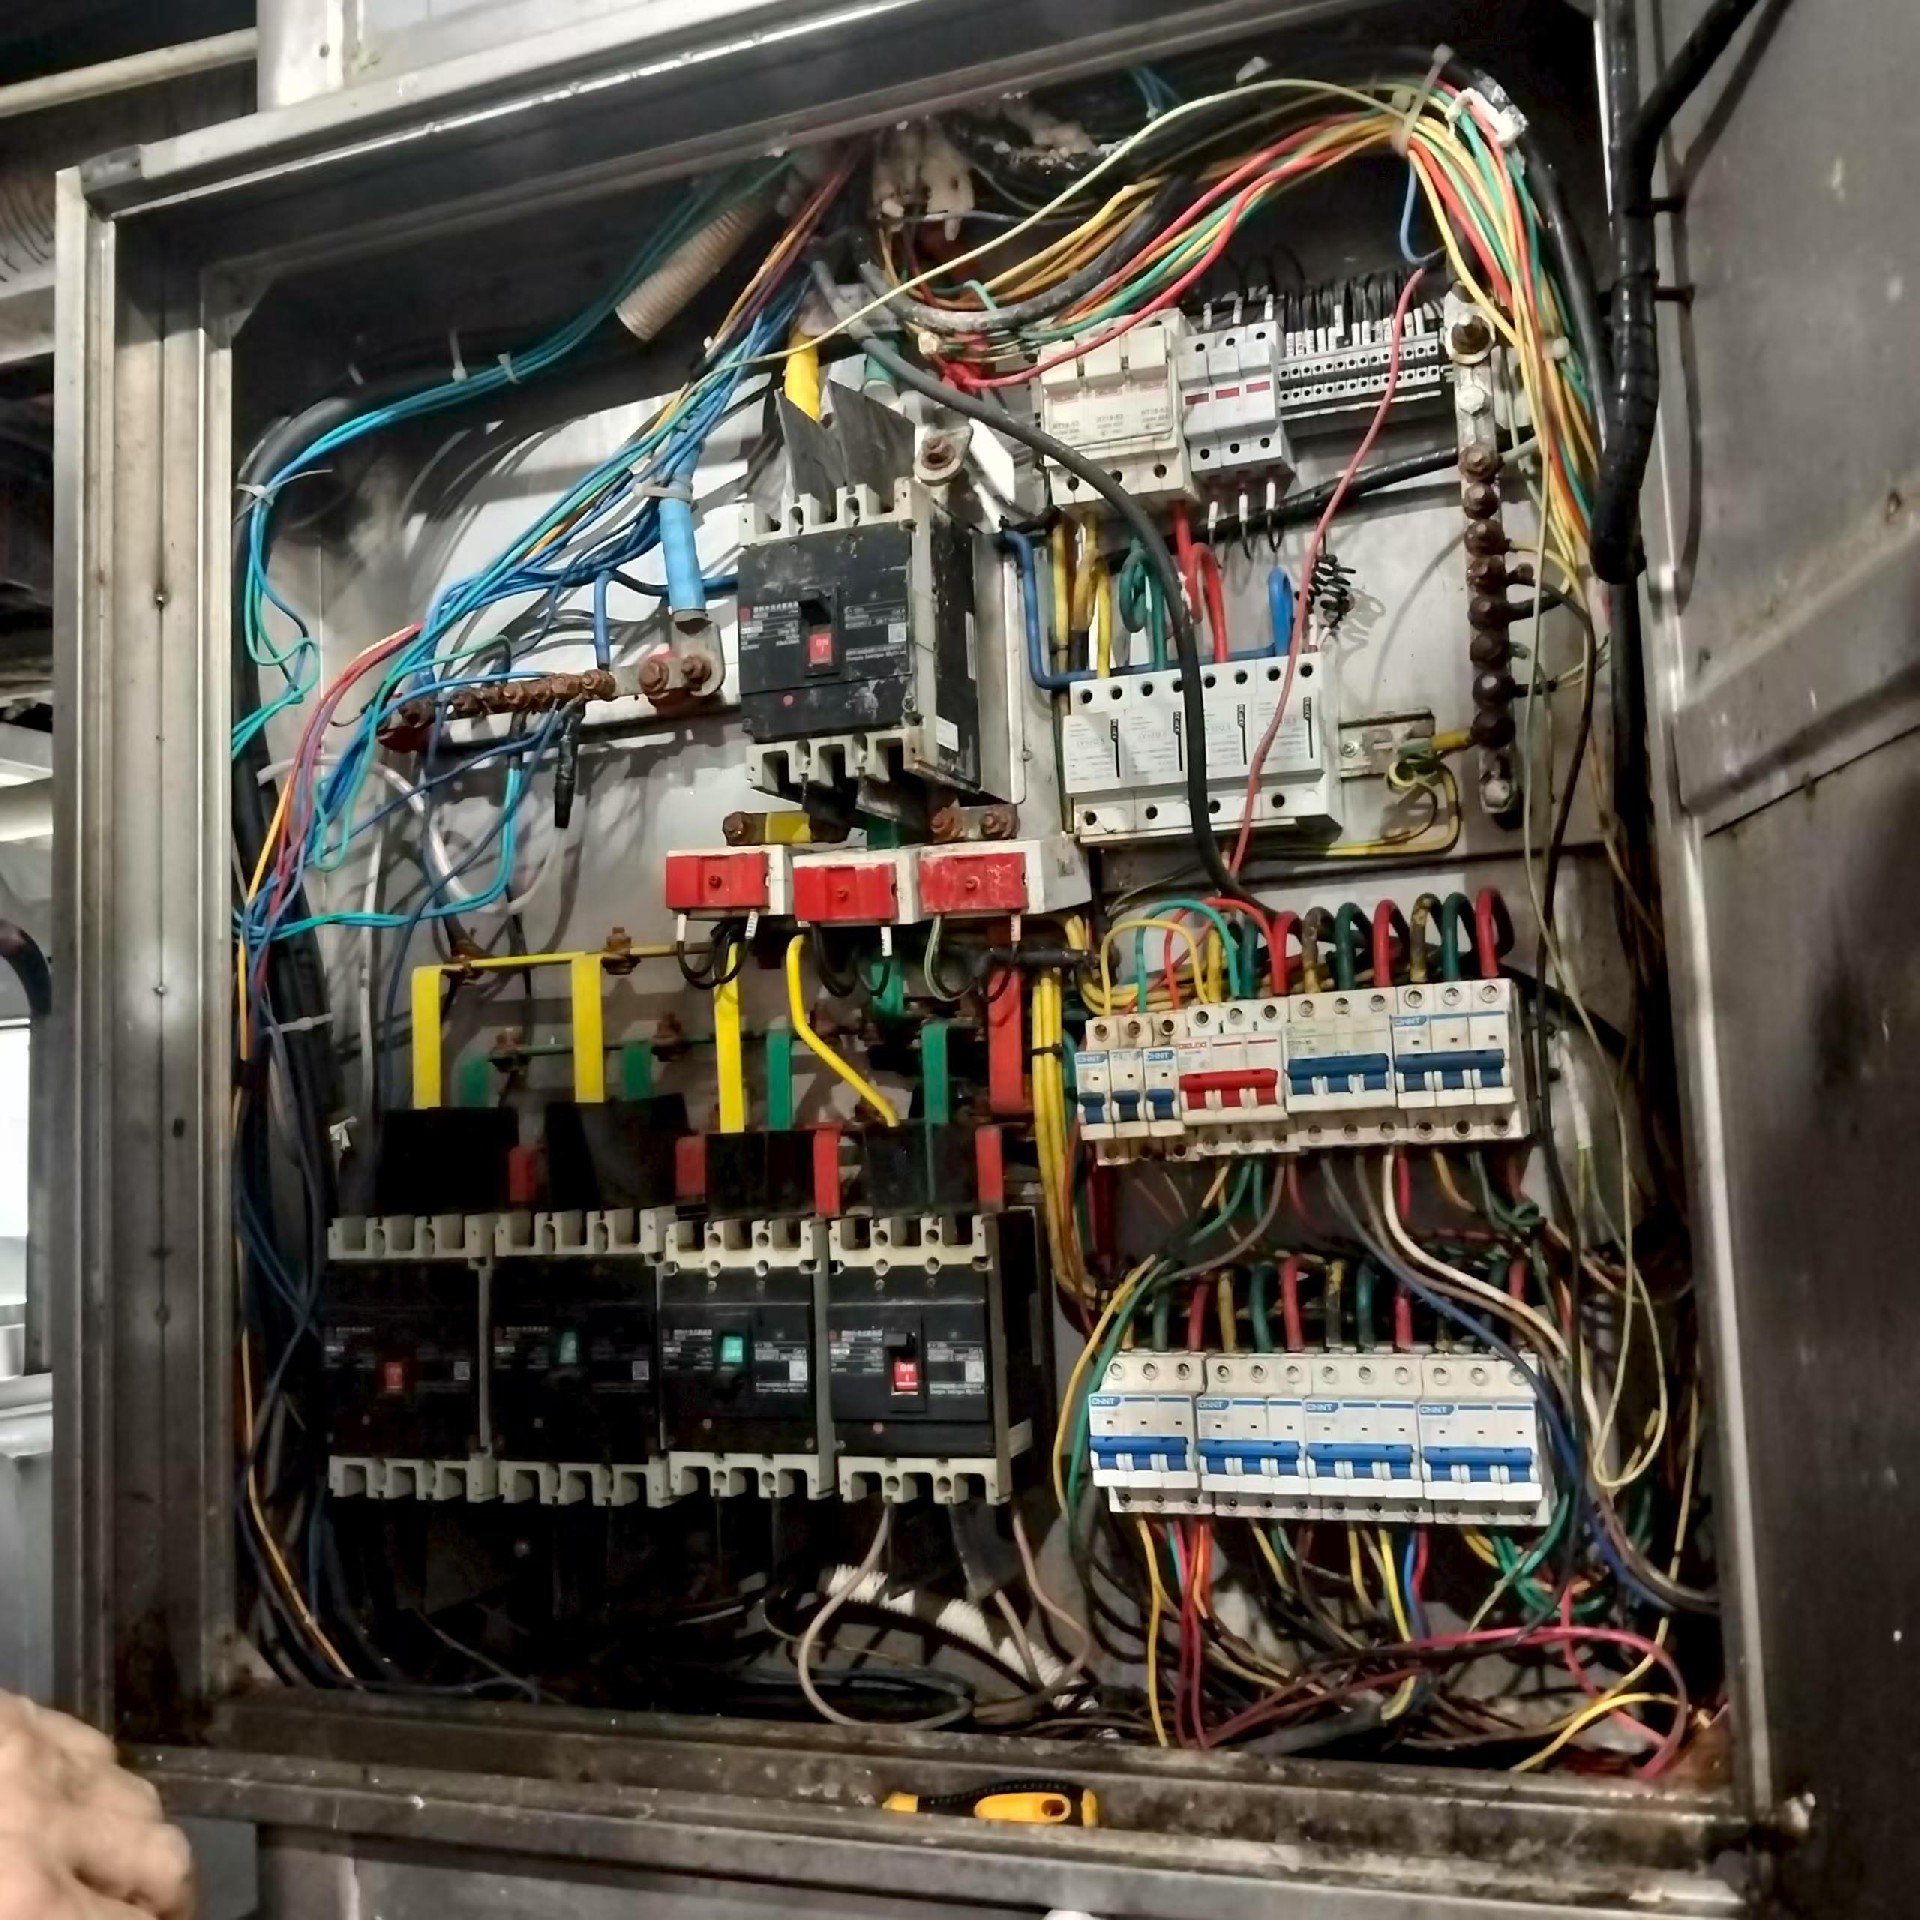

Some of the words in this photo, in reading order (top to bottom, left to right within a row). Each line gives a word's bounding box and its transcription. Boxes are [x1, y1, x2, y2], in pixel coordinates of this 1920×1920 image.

[900, 1364, 914, 1372] ON
[1091, 1397, 1115, 1405] CHNT
[1199, 1400, 1223, 1409] CHNT
[1306, 1403, 1333, 1411] CHNT
[1420, 1406, 1447, 1414] CHNT
